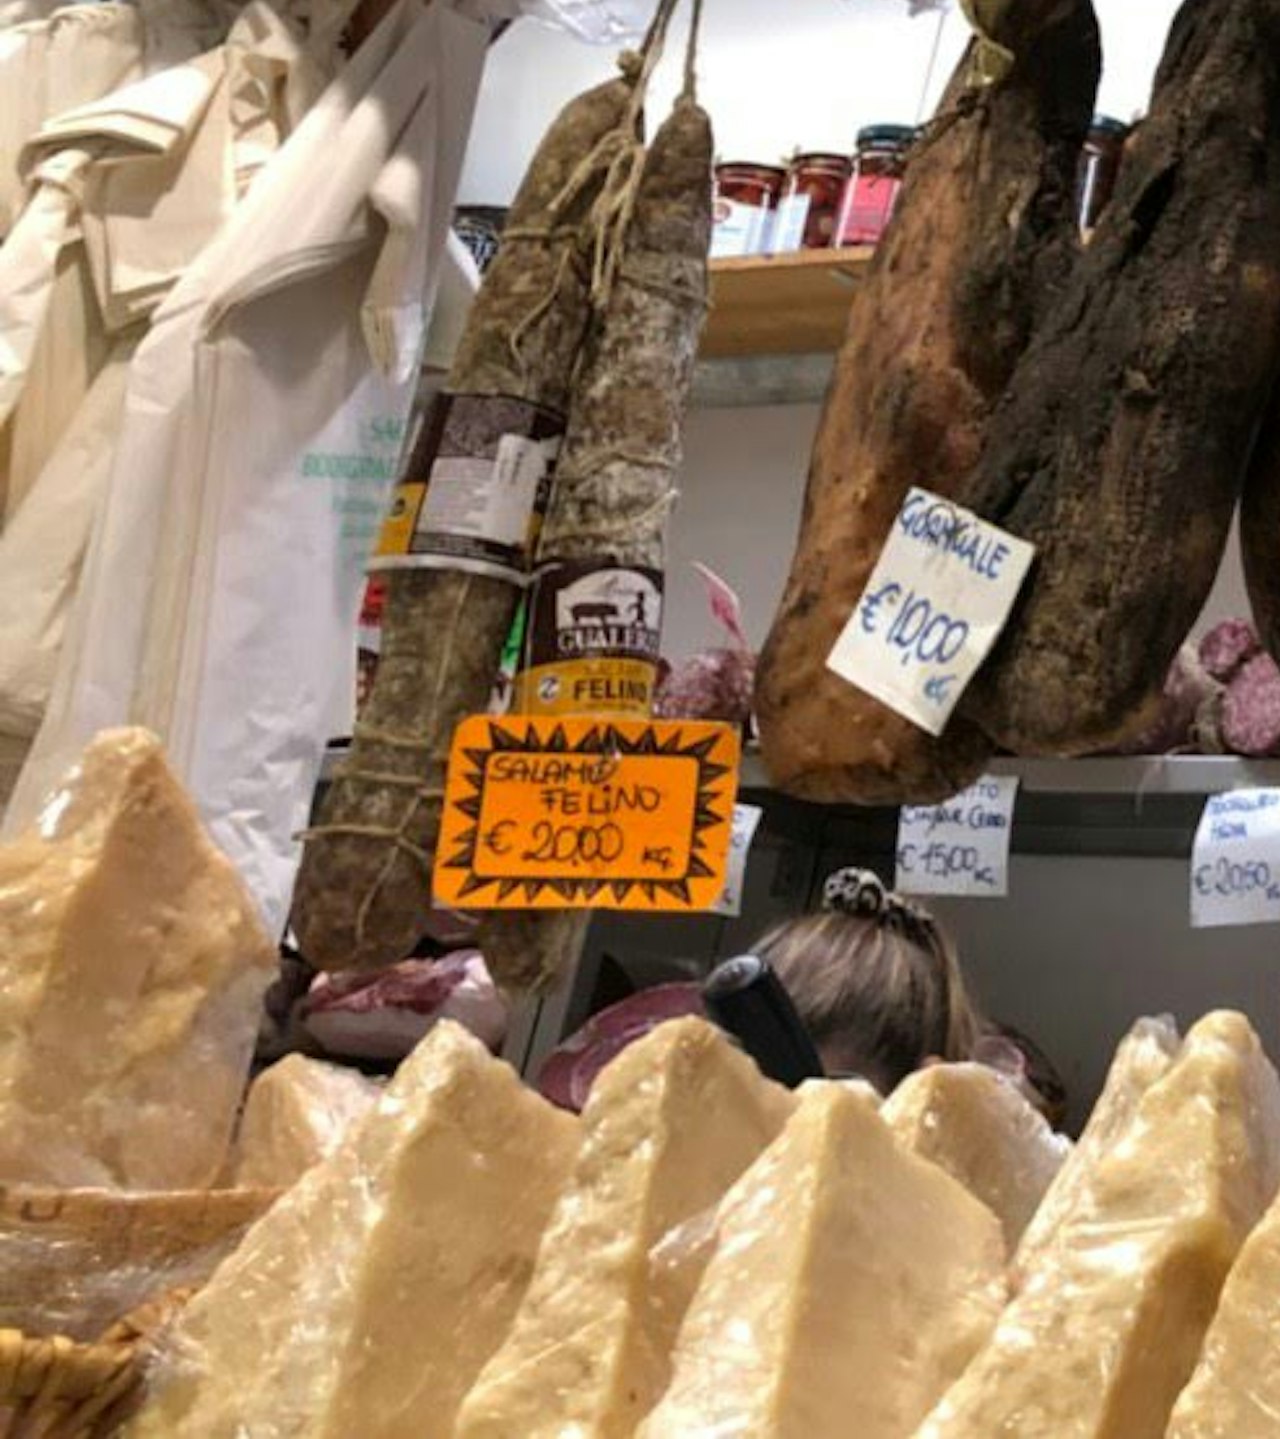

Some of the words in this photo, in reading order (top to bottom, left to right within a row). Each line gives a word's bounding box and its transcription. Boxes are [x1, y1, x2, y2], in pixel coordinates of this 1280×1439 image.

[860, 582, 902, 632] €
[540, 784, 661, 814] FELINO
[484, 819, 518, 854] €
